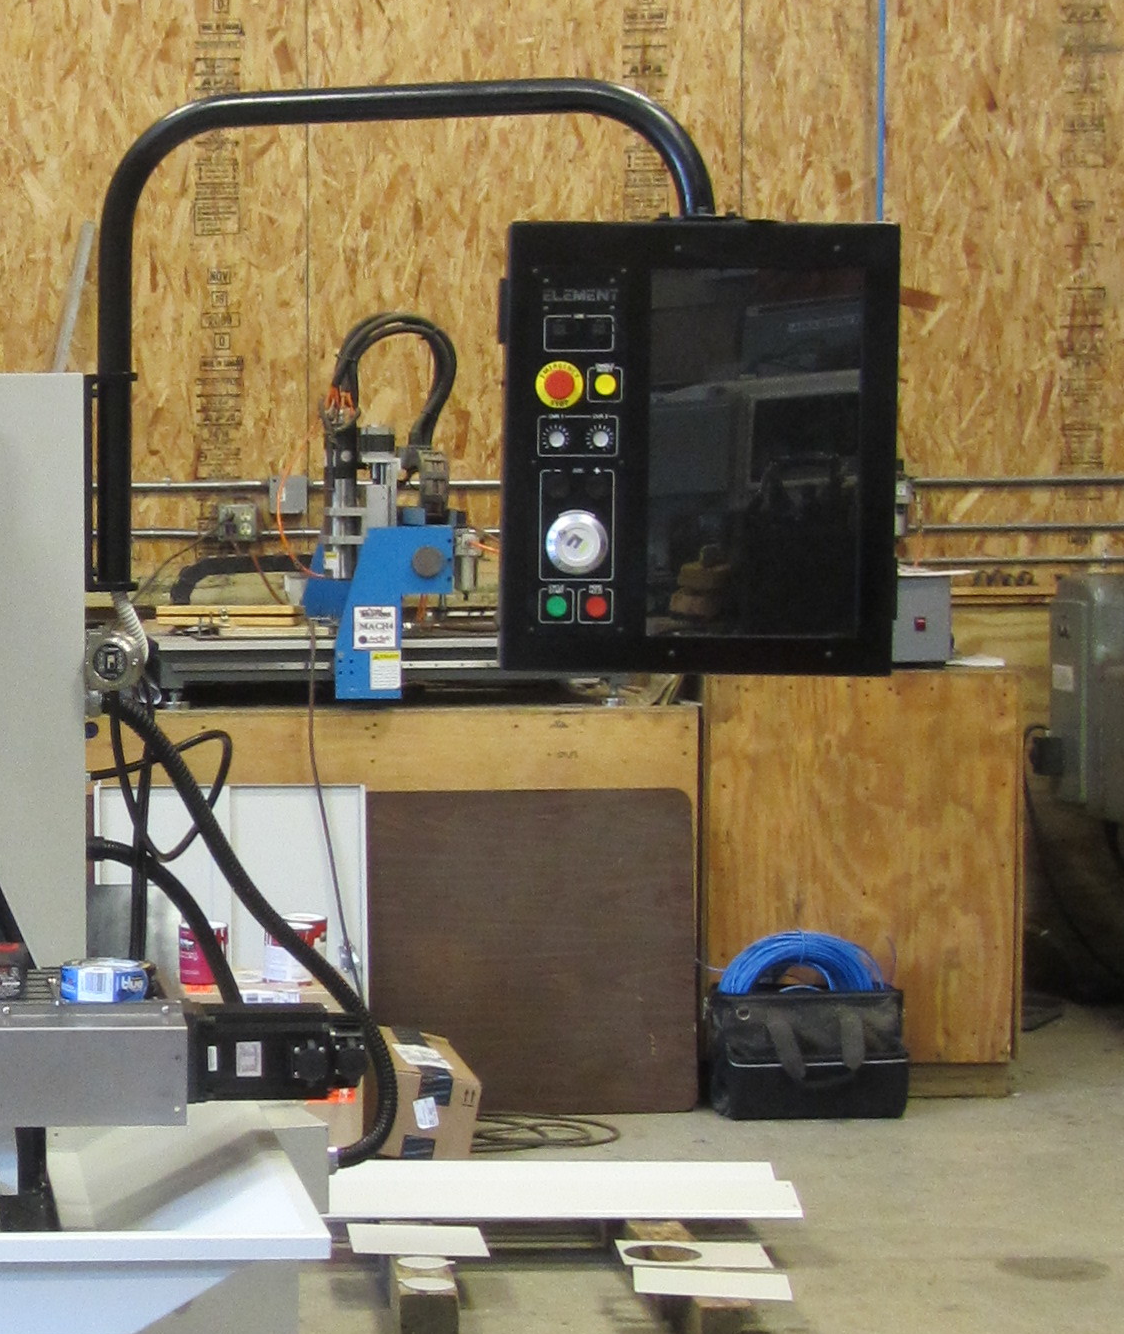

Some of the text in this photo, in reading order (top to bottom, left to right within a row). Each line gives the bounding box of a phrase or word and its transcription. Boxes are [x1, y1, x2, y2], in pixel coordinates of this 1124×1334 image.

[542, 288, 618, 302] ELEMENT
[539, 363, 579, 378] EMERGENCY
[121, 975, 144, 993] blue
